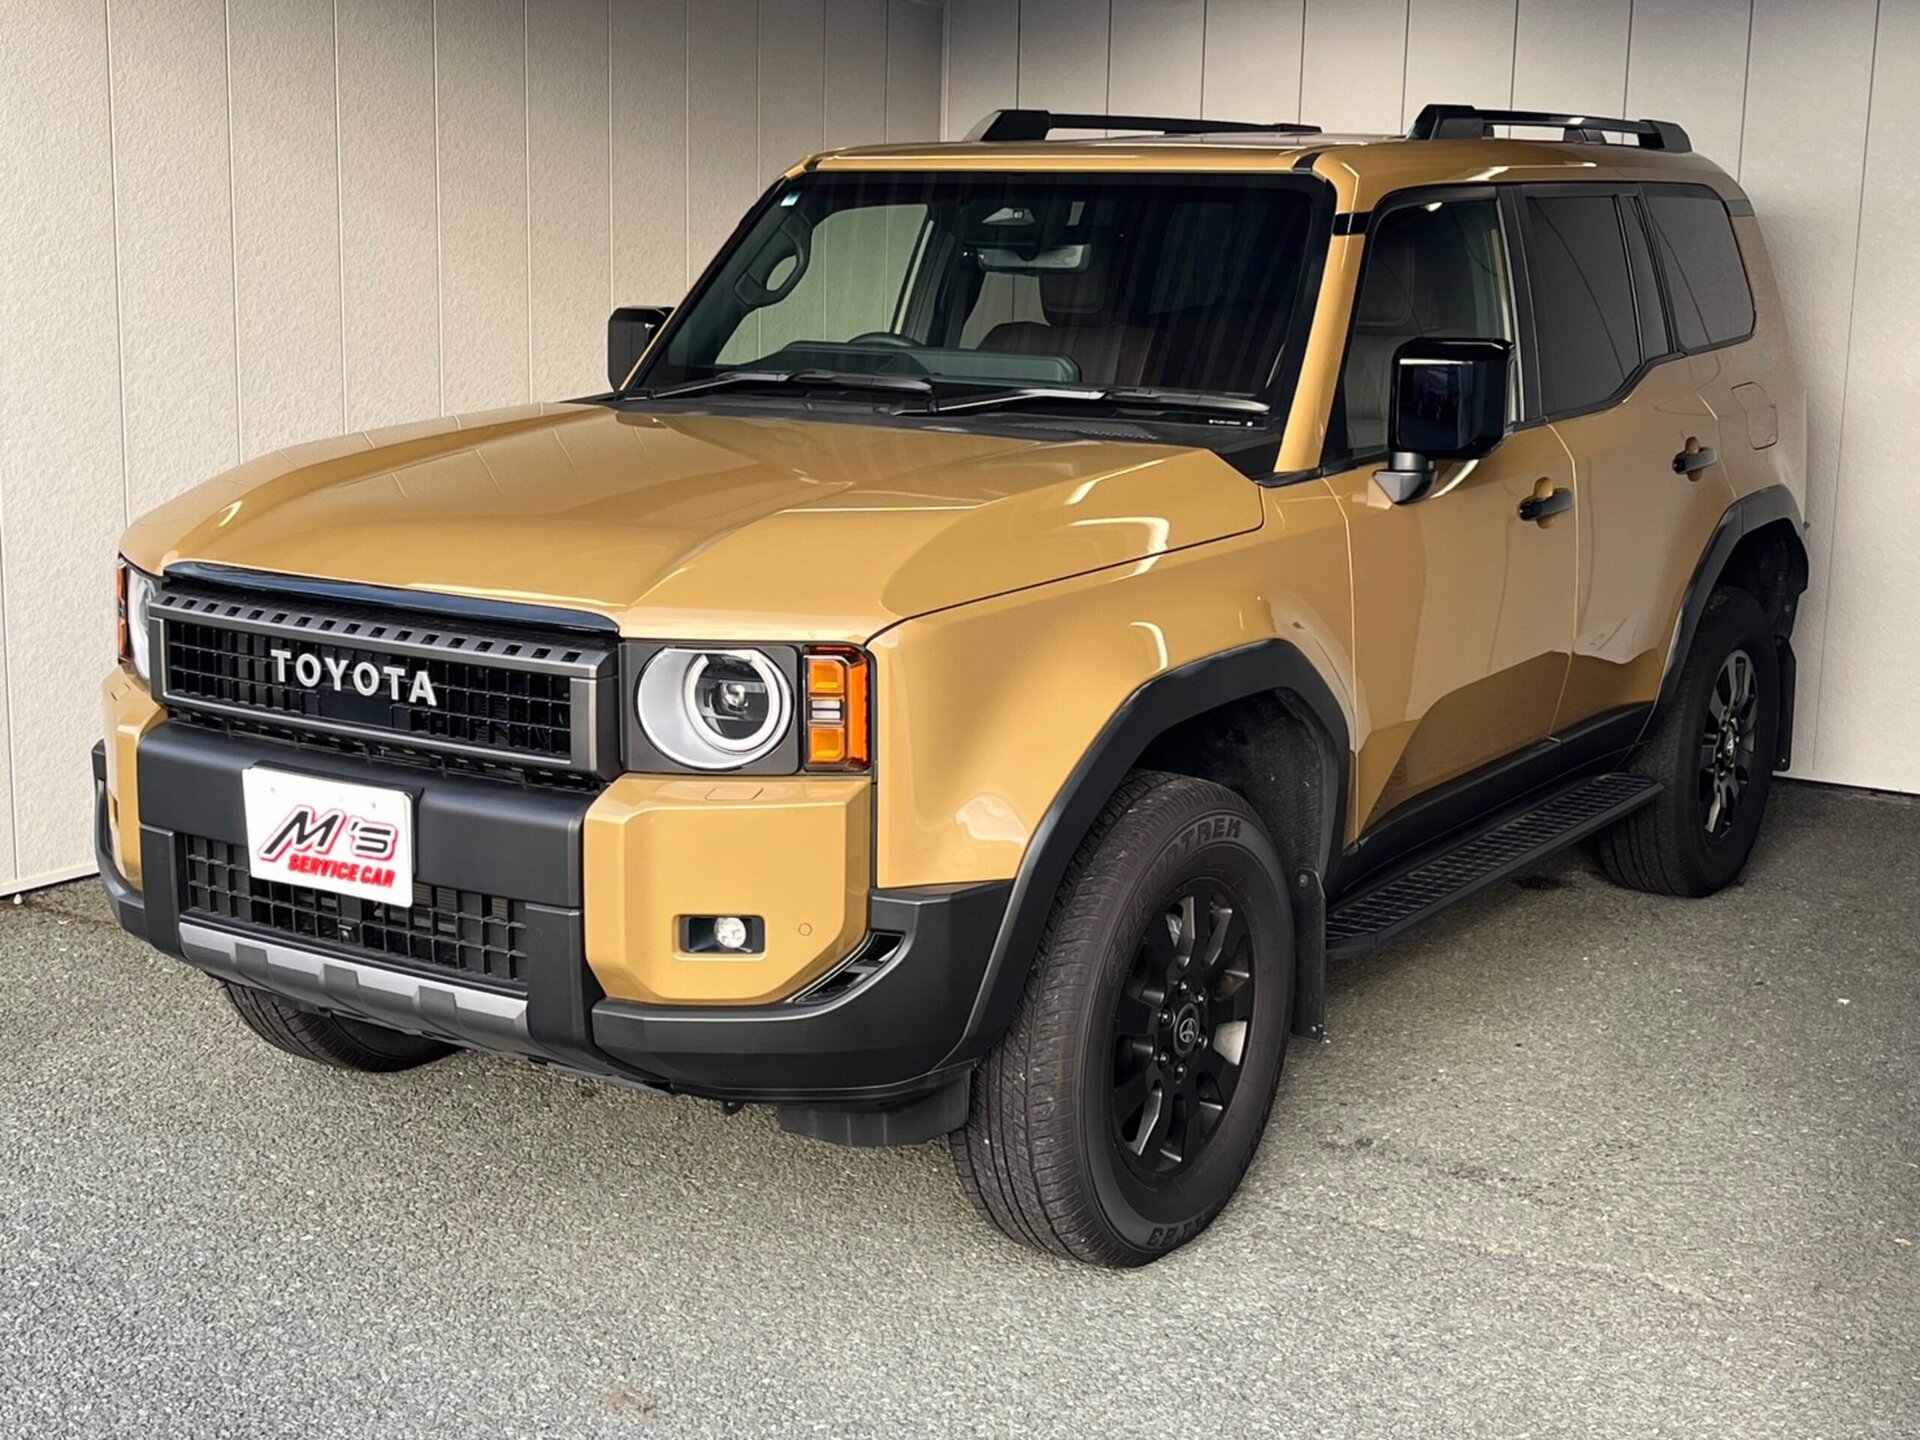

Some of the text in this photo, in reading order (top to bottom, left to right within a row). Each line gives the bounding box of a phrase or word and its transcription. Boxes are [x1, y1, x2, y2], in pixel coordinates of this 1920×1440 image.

[270, 649, 437, 706] TOYOTA
[287, 853, 396, 888] SERVICE CAR
